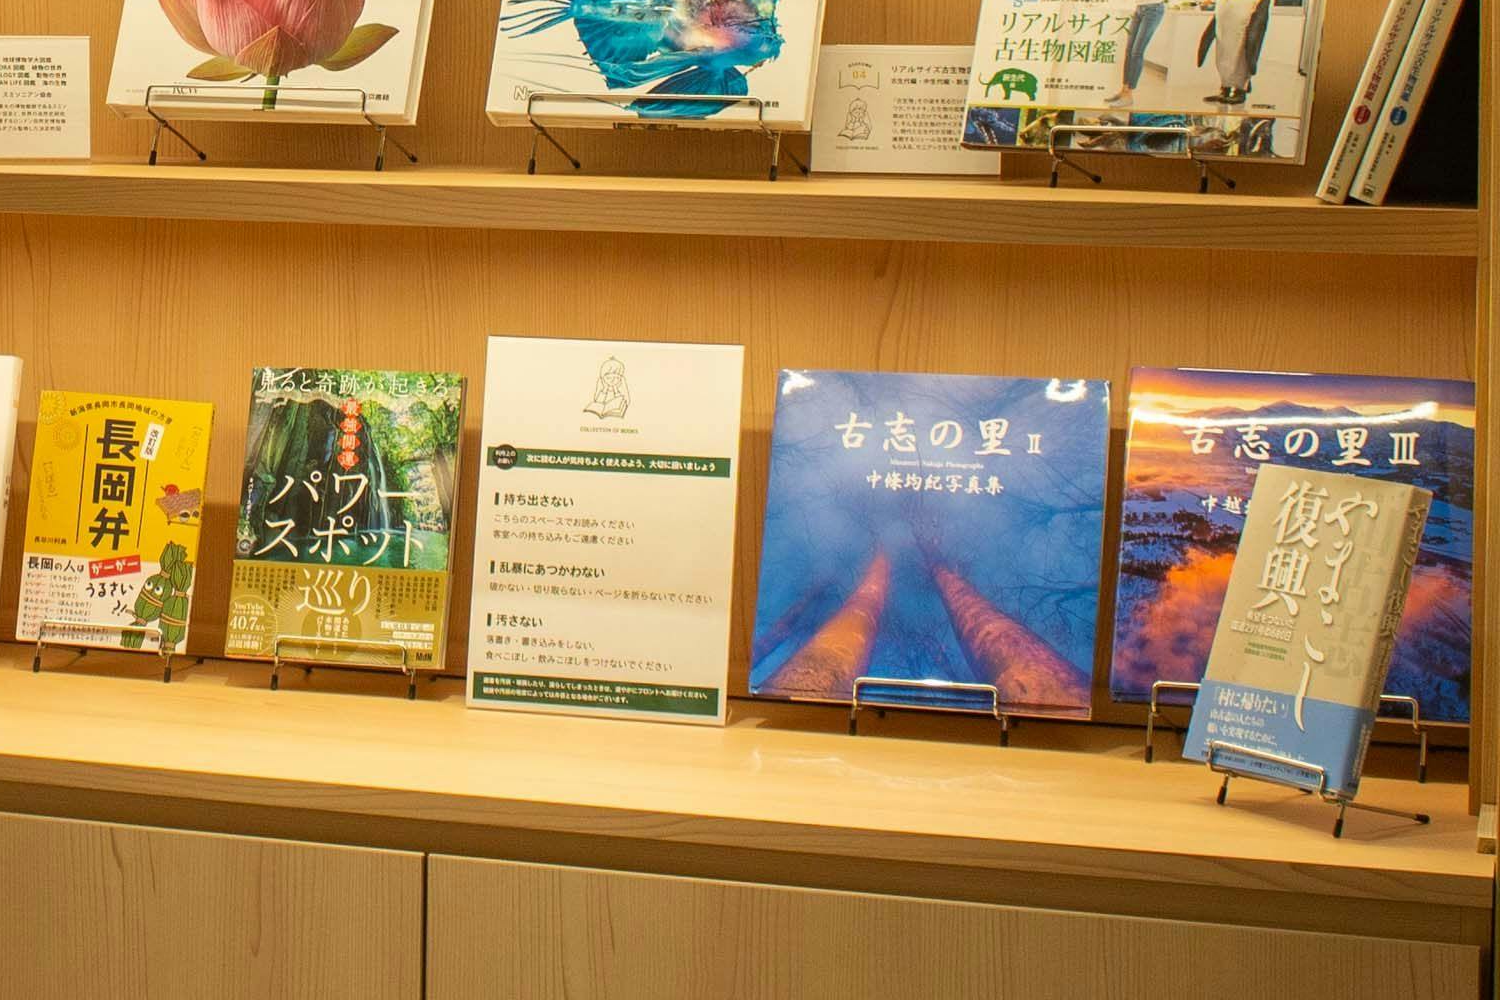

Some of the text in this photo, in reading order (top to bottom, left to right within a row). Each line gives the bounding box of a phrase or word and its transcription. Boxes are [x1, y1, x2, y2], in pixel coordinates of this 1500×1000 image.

[1002, 12, 1132, 35] リアルサイズ
[995, 37, 1117, 64] 古生物図鑑
[834, 412, 1011, 456] 古志の里
[1183, 424, 1372, 466] 古志の里
[88, 418, 140, 551] 長岡弁
[269, 471, 422, 515] パワー
[503, 493, 574, 508] 持ち出さない
[1202, 495, 1251, 515] 中越
[494, 513, 635, 530] こちらのスペースでお読みください
[254, 515, 425, 568] スポット
[1251, 480, 1329, 617] 復興
[28, 556, 139, 575] 長岡の人は がーがー
[499, 561, 605, 578] 乱暴にあつかわない
[86, 581, 134, 598] うるさい
[296, 568, 372, 616] 巡り
[496, 613, 543, 628] 汚さない
[1213, 686, 1289, 718] 「村に帰りたい」
